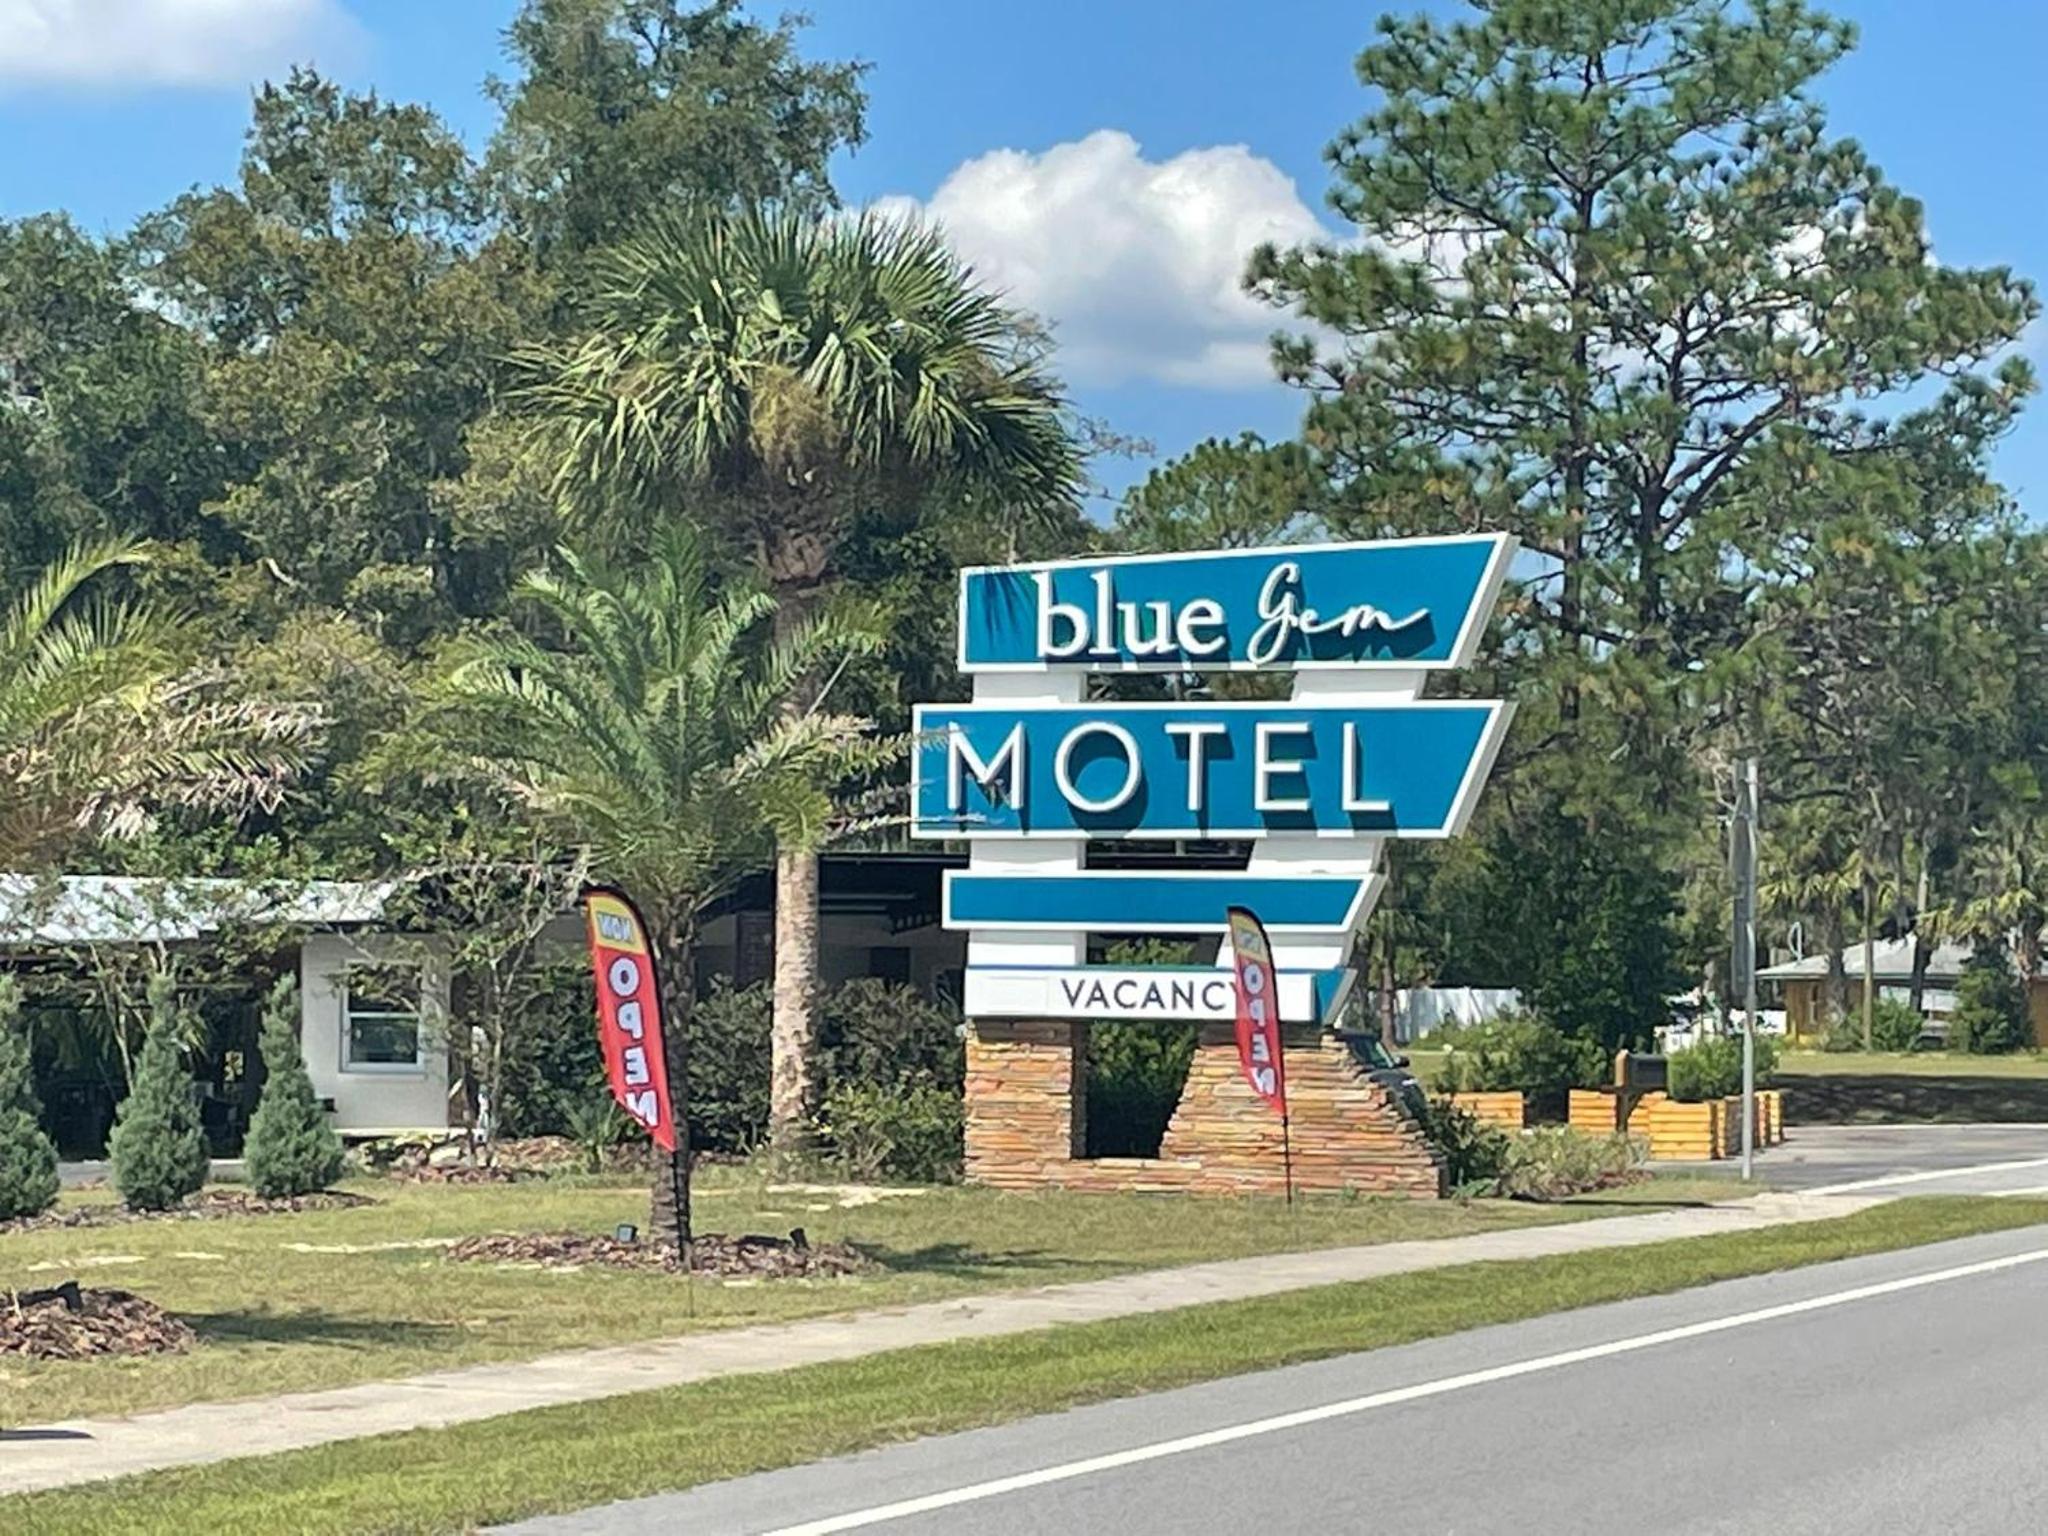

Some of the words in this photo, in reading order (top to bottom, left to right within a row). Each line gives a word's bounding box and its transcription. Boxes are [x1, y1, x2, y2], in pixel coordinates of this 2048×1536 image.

[1031, 569, 1226, 657] blue
[1246, 562, 1430, 665] Gem
[947, 720, 1389, 812] MOTEL
